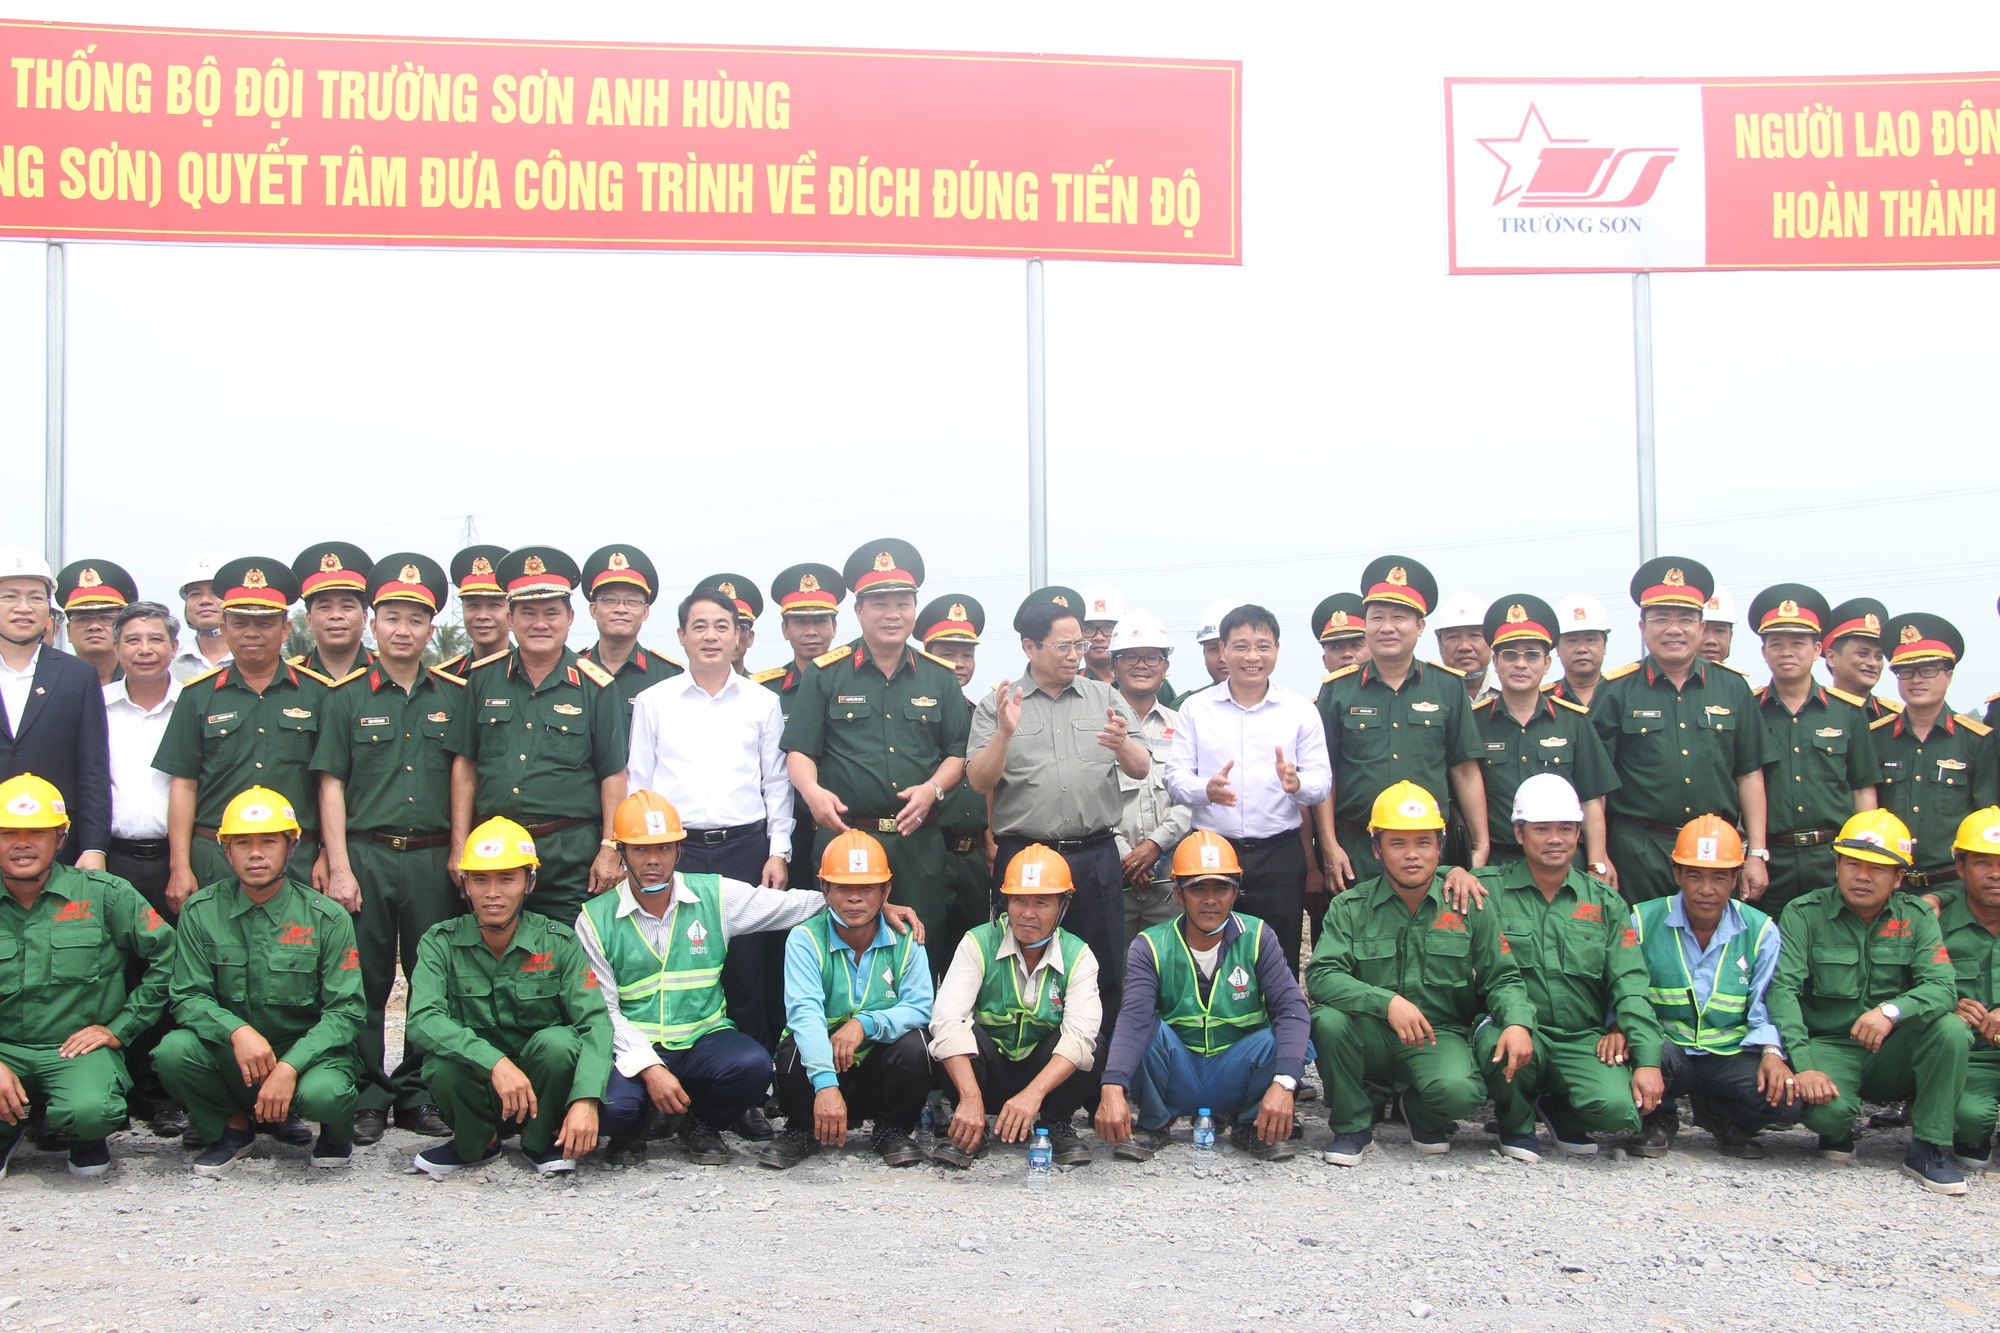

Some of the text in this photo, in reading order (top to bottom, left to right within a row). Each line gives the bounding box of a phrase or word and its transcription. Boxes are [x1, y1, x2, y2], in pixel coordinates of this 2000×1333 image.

[10, 44, 791, 130] THỐNG BỘ ĐỘI TRƯỜNG SƠN ANH HÙNG
[1734, 99, 2000, 167] NGƯỜI LAO ĐỘN
[59, 141, 162, 208] SƠN)
[178, 136, 308, 210] QUYẾT
[320, 144, 407, 208] TÂM
[420, 151, 502, 209] ĐƯA
[514, 148, 624, 212] CÔNG
[636, 151, 754, 214] TRÌNH
[766, 149, 816, 216] VỀ
[828, 155, 920, 218] ĐÍCH
[932, 159, 1039, 222] ĐÚNG
[1051, 158, 1139, 225] TIẾN
[1150, 167, 1201, 239] ĐỘ
[1773, 179, 1996, 239] HOÀN THÀNH
[1498, 212, 1642, 234] TRƯỜNG SƠN
